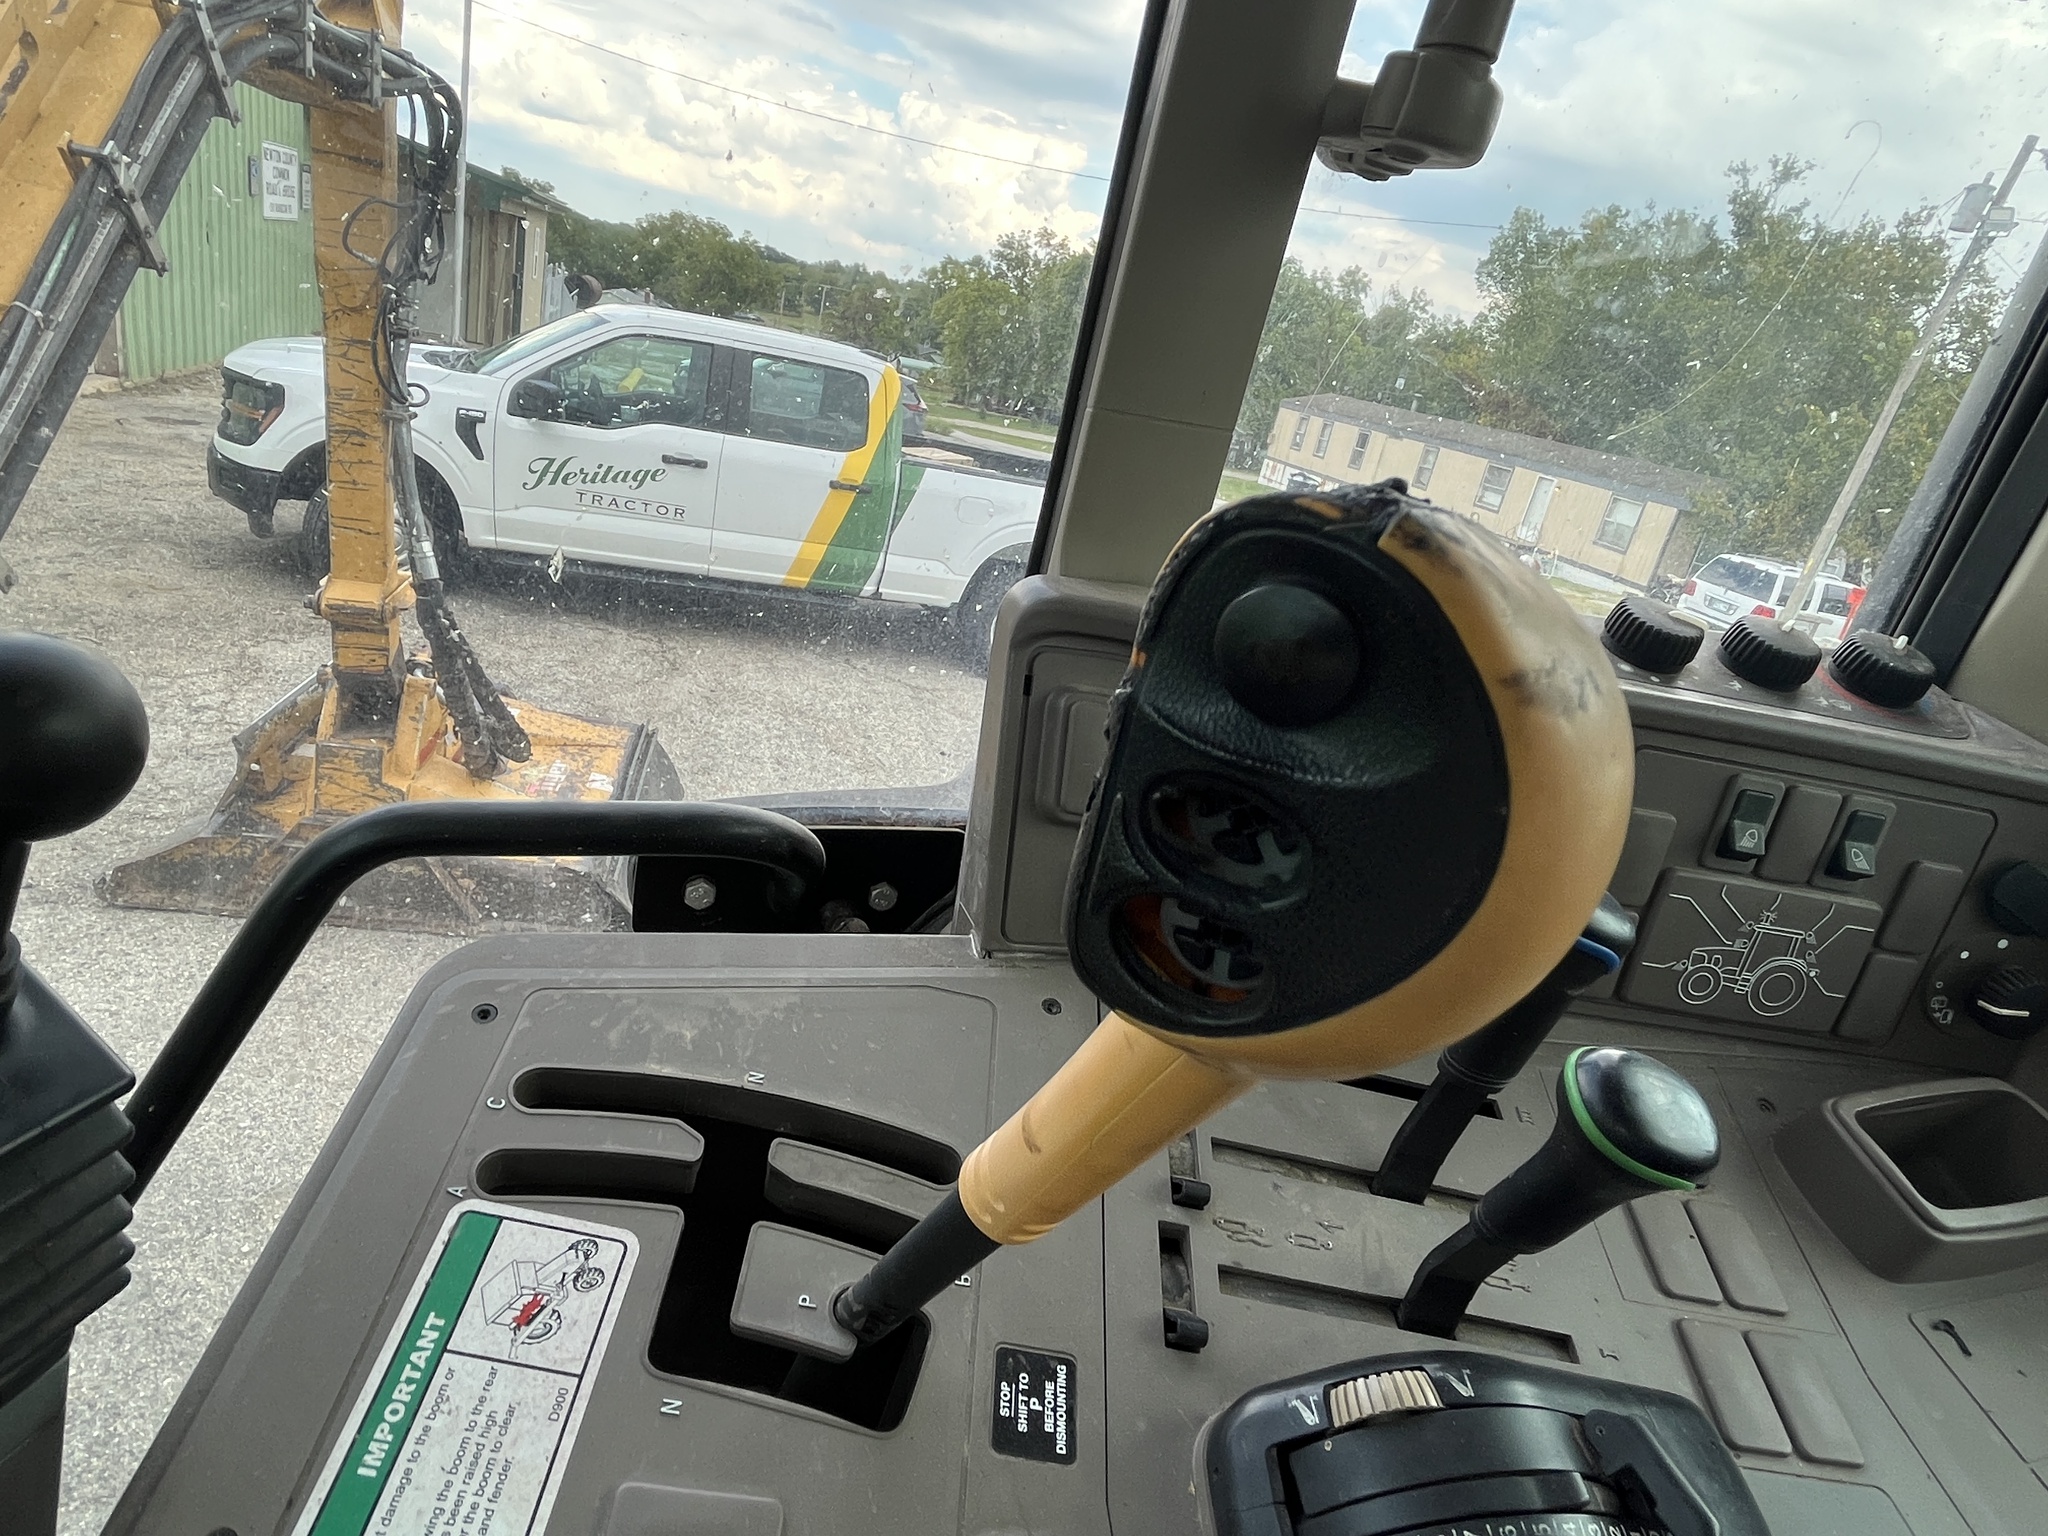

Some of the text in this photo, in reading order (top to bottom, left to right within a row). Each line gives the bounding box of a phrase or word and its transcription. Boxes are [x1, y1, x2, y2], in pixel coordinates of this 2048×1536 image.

[522, 455, 668, 491] Heritage
[575, 491, 687, 519] TRACTOR
[486, 1096, 506, 1110] C
[446, 1186, 467, 1198] A
[798, 1294, 817, 1308] P
[356, 1311, 446, 1478] IMPORTANT
[482, 1365, 499, 1392] rear
[470, 1395, 487, 1416] the
[547, 1387, 569, 1422] D900
[660, 1397, 683, 1416] N
[1000, 1381, 1011, 1418] STOP
[1018, 1372, 1029, 1433] SHIFT TO
[1029, 1397, 1043, 1411] P
[1044, 1380, 1055, 1433] BEFORE
[1056, 1364, 1067, 1455] DISMOUNTING
[464, 1419, 478, 1433] to
[380, 1466, 414, 1528] damage
[406, 1449, 421, 1463] to
[414, 1425, 431, 1446] the
[424, 1383, 449, 1421] boom
[445, 1366, 456, 1381] or
[446, 1435, 472, 1475] boom
[443, 1489, 468, 1527] been
[462, 1441, 486, 1486] raised
[478, 1409, 498, 1439] high
[462, 1501, 480, 1525] the
[472, 1457, 497, 1498] boom
[490, 1440, 503, 1453] to
[436, 1479, 454, 1502] the
[478, 1456, 515, 1536] and fender.
